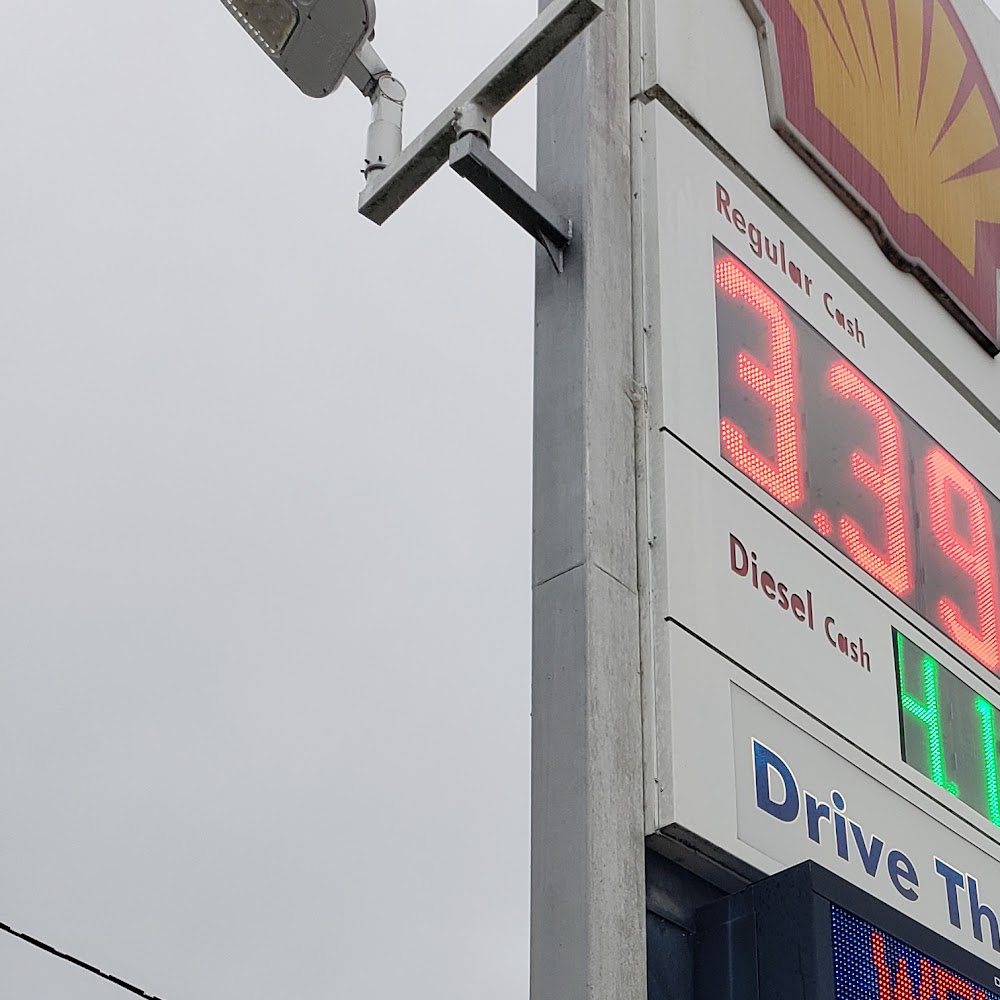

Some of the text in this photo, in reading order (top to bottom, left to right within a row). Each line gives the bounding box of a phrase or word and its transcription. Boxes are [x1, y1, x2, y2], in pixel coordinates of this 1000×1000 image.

[716, 180, 866, 349] Regular Cash
[729, 532, 871, 673] Diesel Cash
[751, 737, 919, 902] Drive
